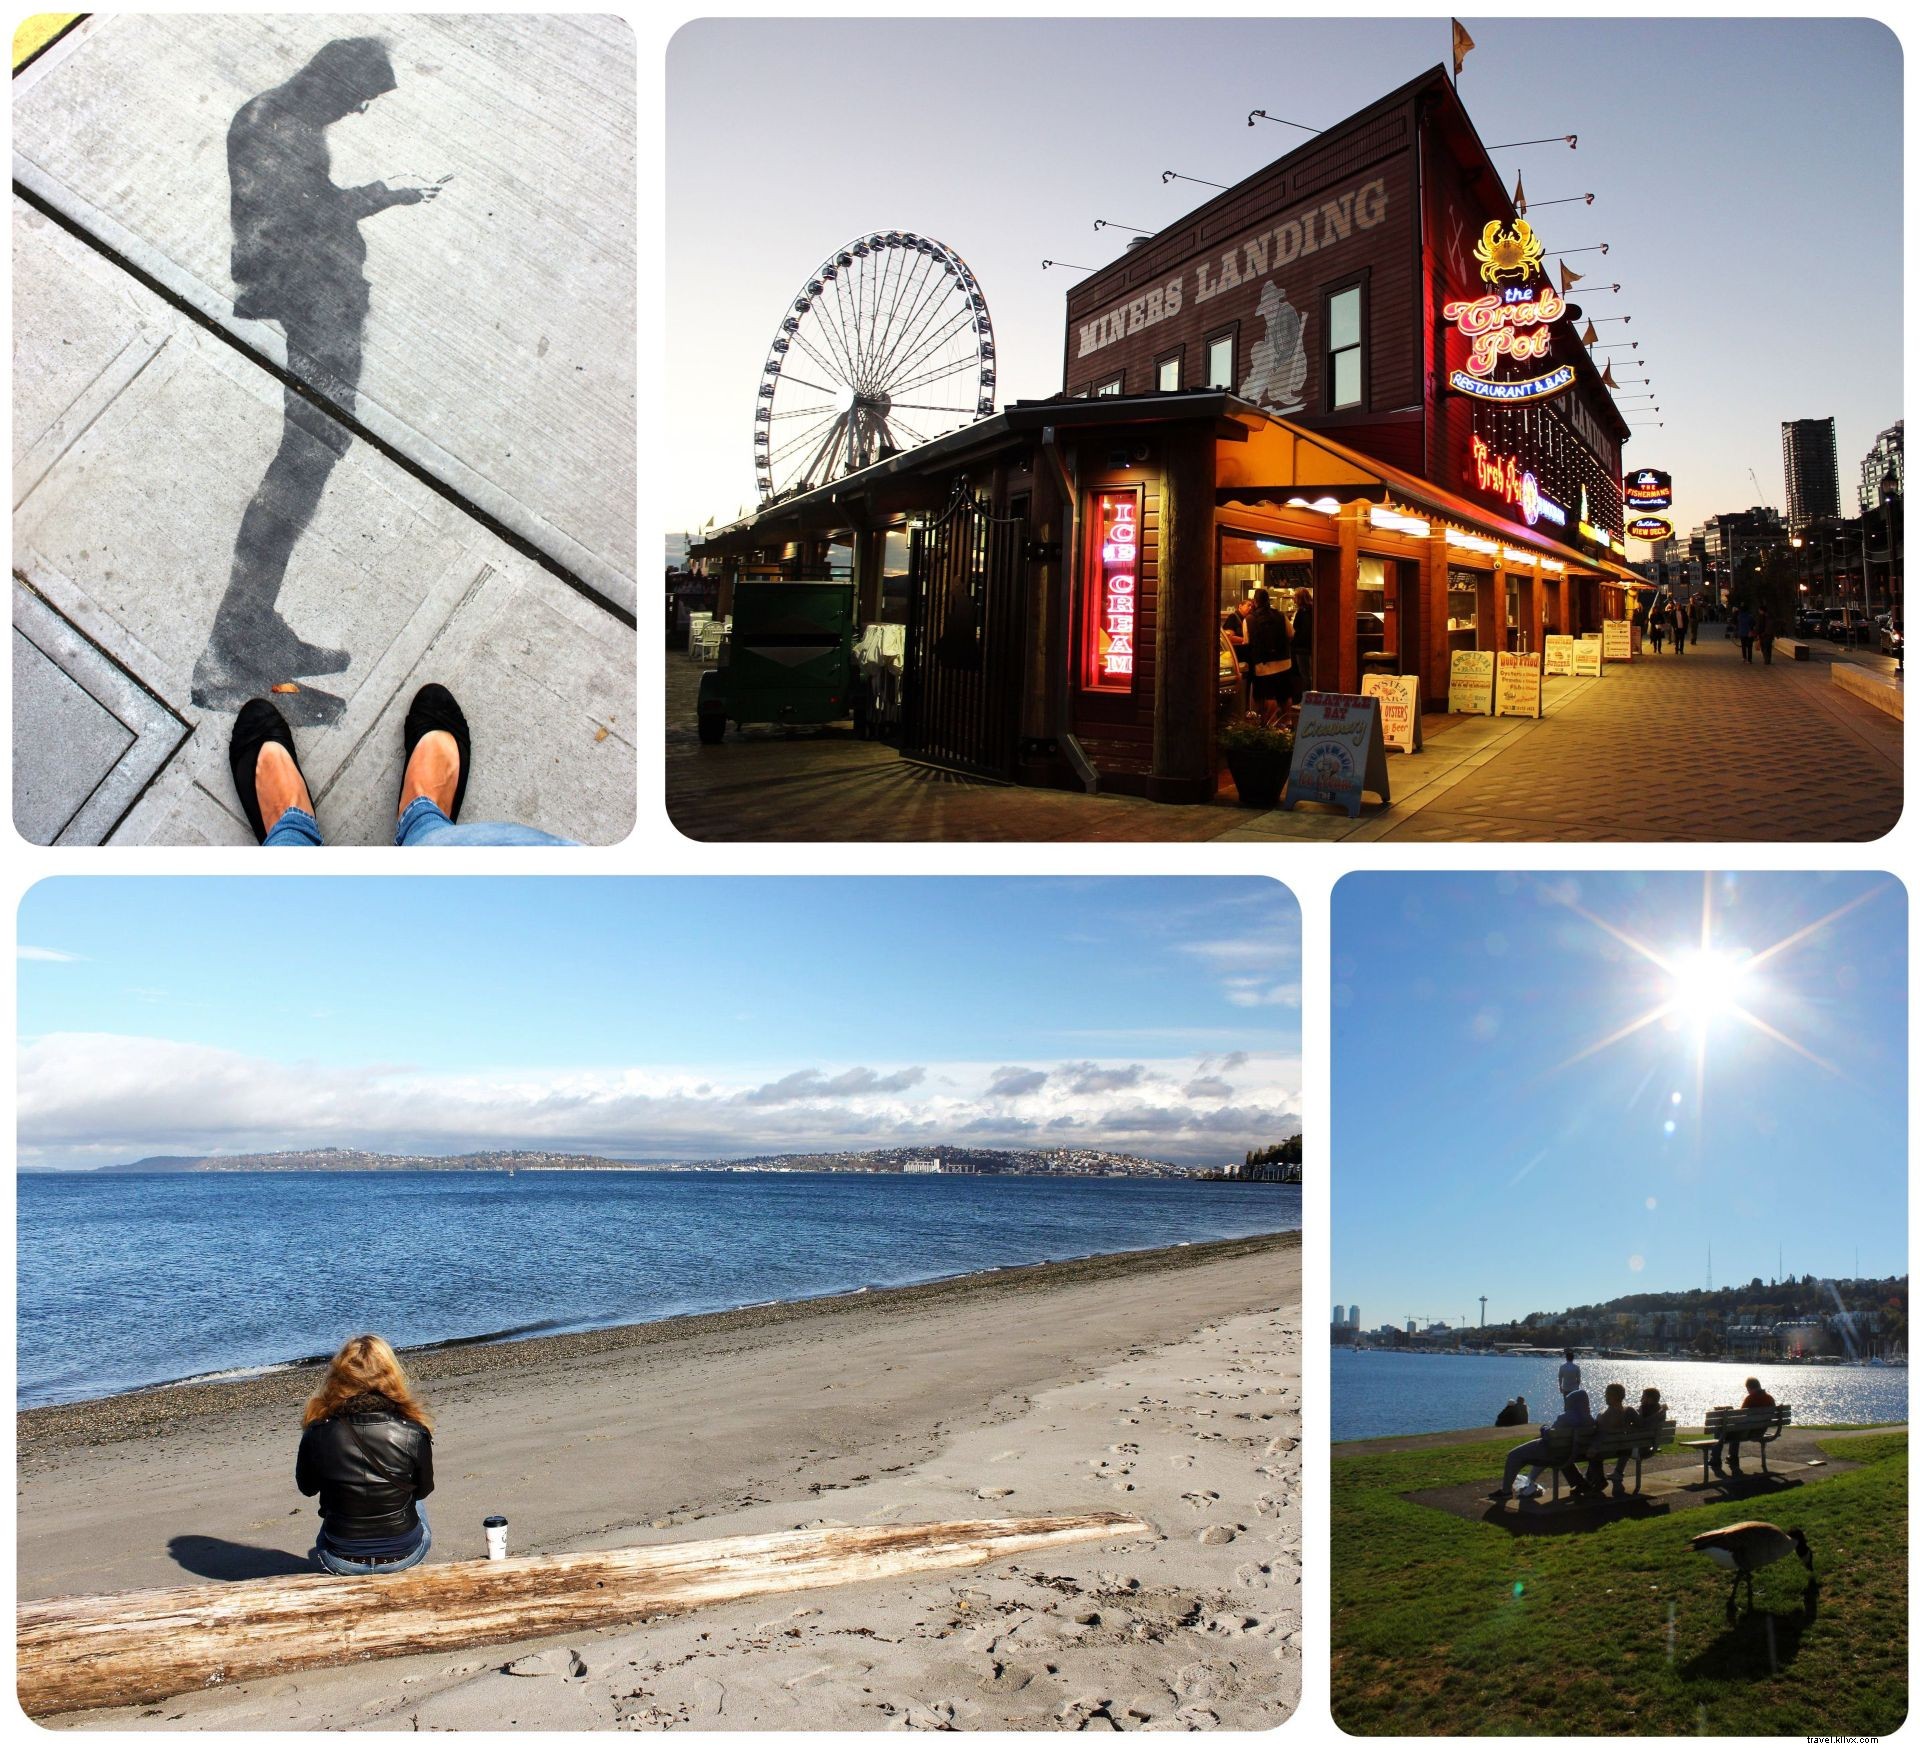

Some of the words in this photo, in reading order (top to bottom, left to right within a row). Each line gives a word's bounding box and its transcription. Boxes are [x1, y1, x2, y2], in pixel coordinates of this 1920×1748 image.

[1078, 276, 1183, 359] MINERS
[1195, 178, 1389, 305] LANDING
[1505, 288, 1533, 303] the
[1443, 288, 1566, 336] Crab
[1466, 324, 1552, 376] Pot
[1453, 372, 1533, 398] RESTAURANT
[1535, 381, 1546, 393] &
[1545, 369, 1571, 389] BAR
[1627, 487, 1670, 498] FISHERMANS
[1107, 503, 1136, 562] ICE
[1632, 527, 1649, 535] VIEW
[1649, 527, 1667, 536] DECK
[1105, 574, 1135, 675] CREAM
[1369, 681, 1408, 698] OYSTER
[1304, 693, 1372, 710] SEATTLE
[1323, 707, 1349, 720] BAY
[1384, 705, 1409, 722] OYSTERS
[1391, 723, 1409, 733] Beer
